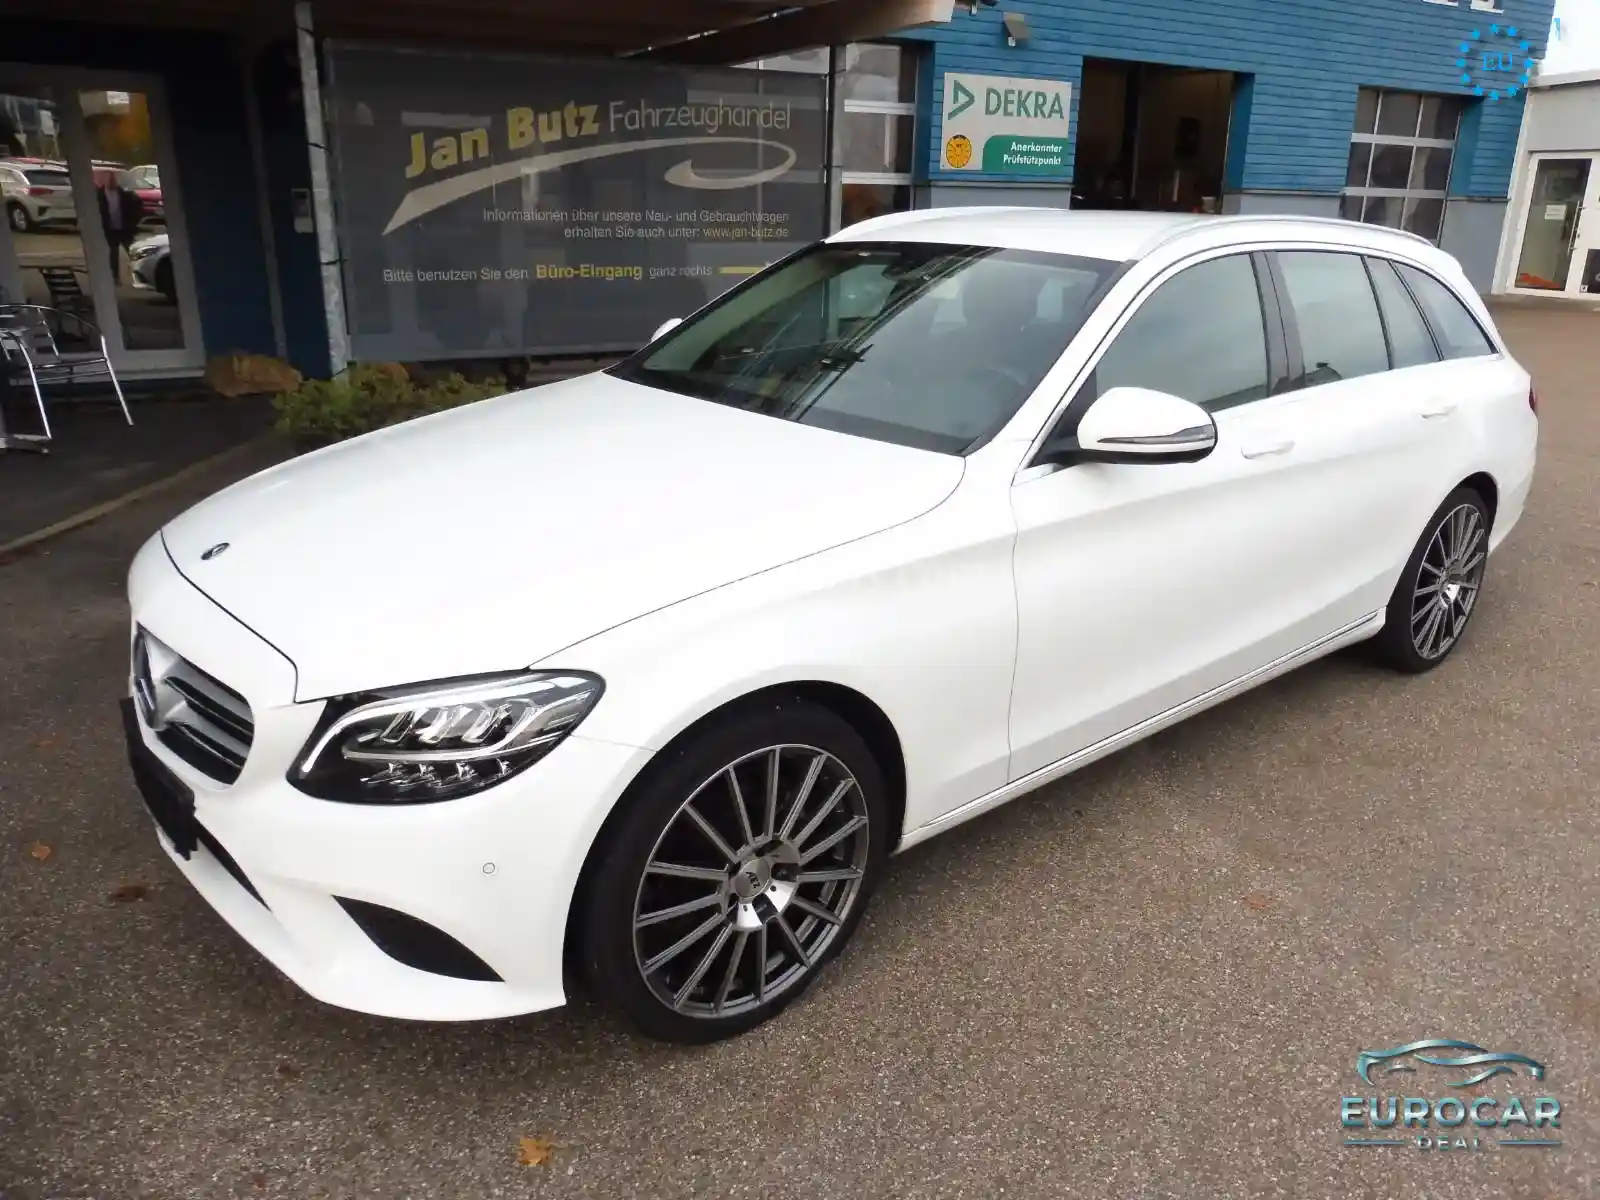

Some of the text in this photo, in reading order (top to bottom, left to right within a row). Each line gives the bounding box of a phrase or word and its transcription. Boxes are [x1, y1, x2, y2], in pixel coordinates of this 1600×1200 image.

[985, 87, 1064, 120] DEKRA
[404, 99, 791, 179] Jan Butz Fahrzeughandel
[1010, 141, 1063, 153] Anerkannter
[1003, 154, 1061, 167] Prüfstützpunkt
[483, 208, 790, 224] Informationen über unsere Neu- und Gebrauchtwagen
[564, 225, 612, 239] erhalten
[615, 225, 635, 239] Sie
[637, 226, 665, 239] auch
[668, 226, 700, 239] unter:
[383, 263, 713, 283] Bitte benutzen Sie den Büro-Eingang ganz rechts
